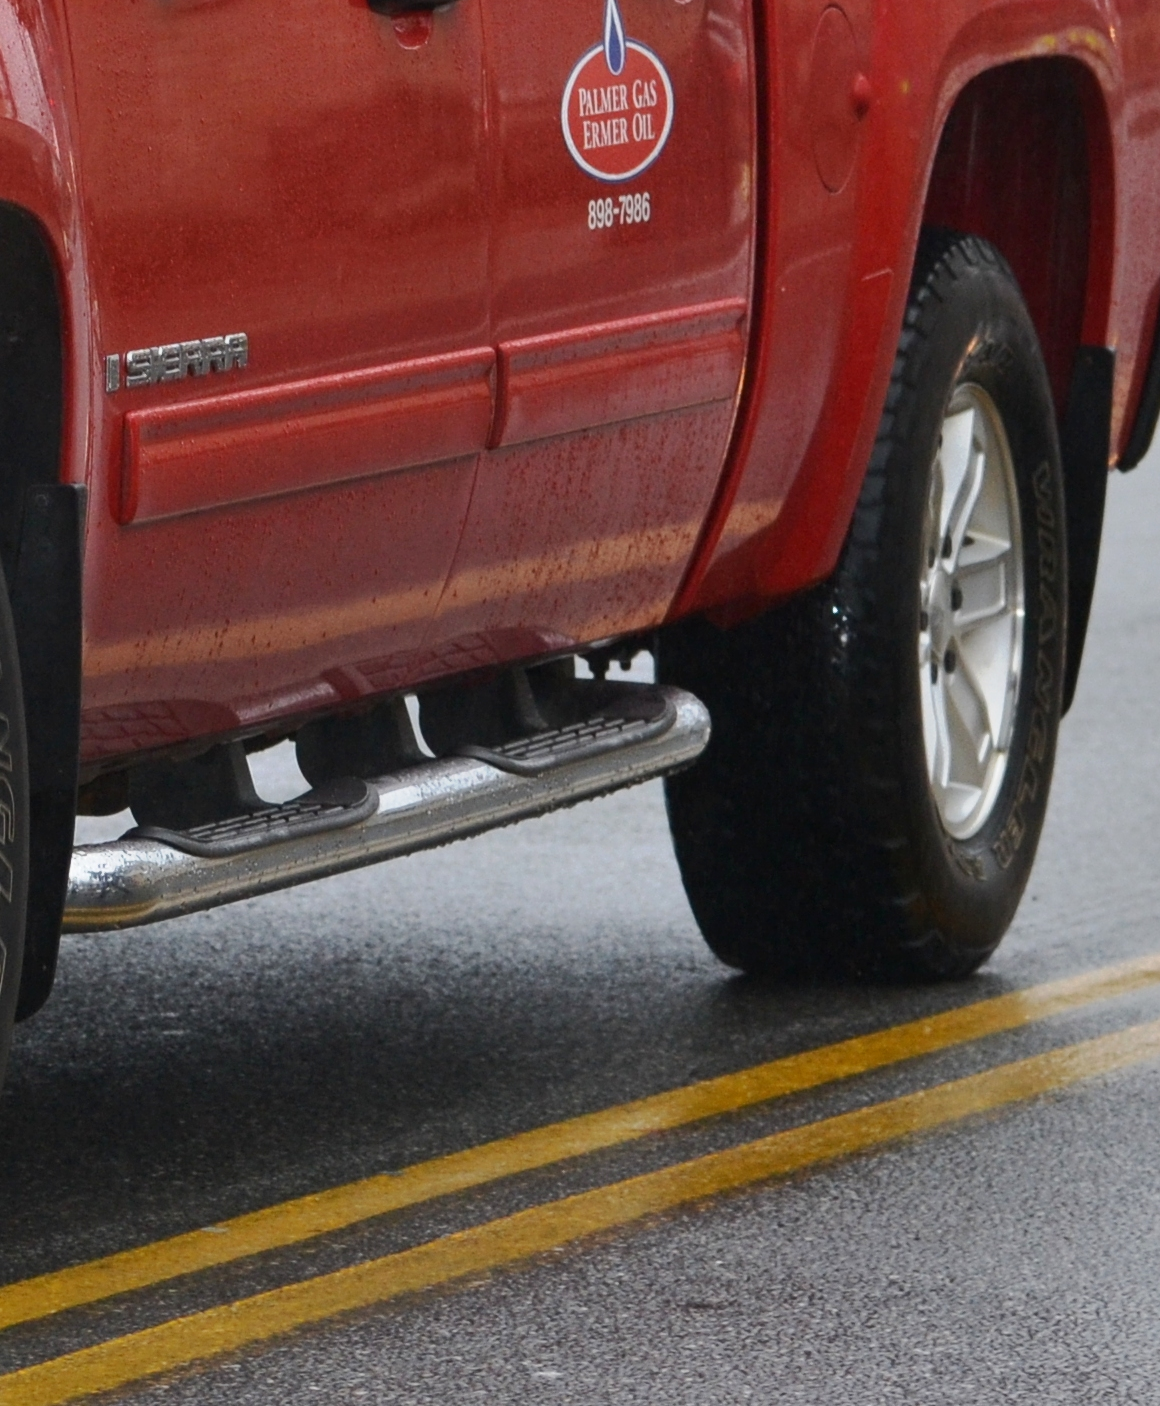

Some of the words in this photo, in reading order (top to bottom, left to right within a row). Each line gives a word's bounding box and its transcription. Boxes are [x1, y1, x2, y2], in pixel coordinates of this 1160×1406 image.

[578, 84, 629, 117] PALMER
[632, 79, 658, 109] GAS
[582, 117, 629, 150] ERMER
[632, 112, 655, 142] OIL
[587, 191, 651, 230] 898-7986
[125, 332, 248, 389] SIERRA
